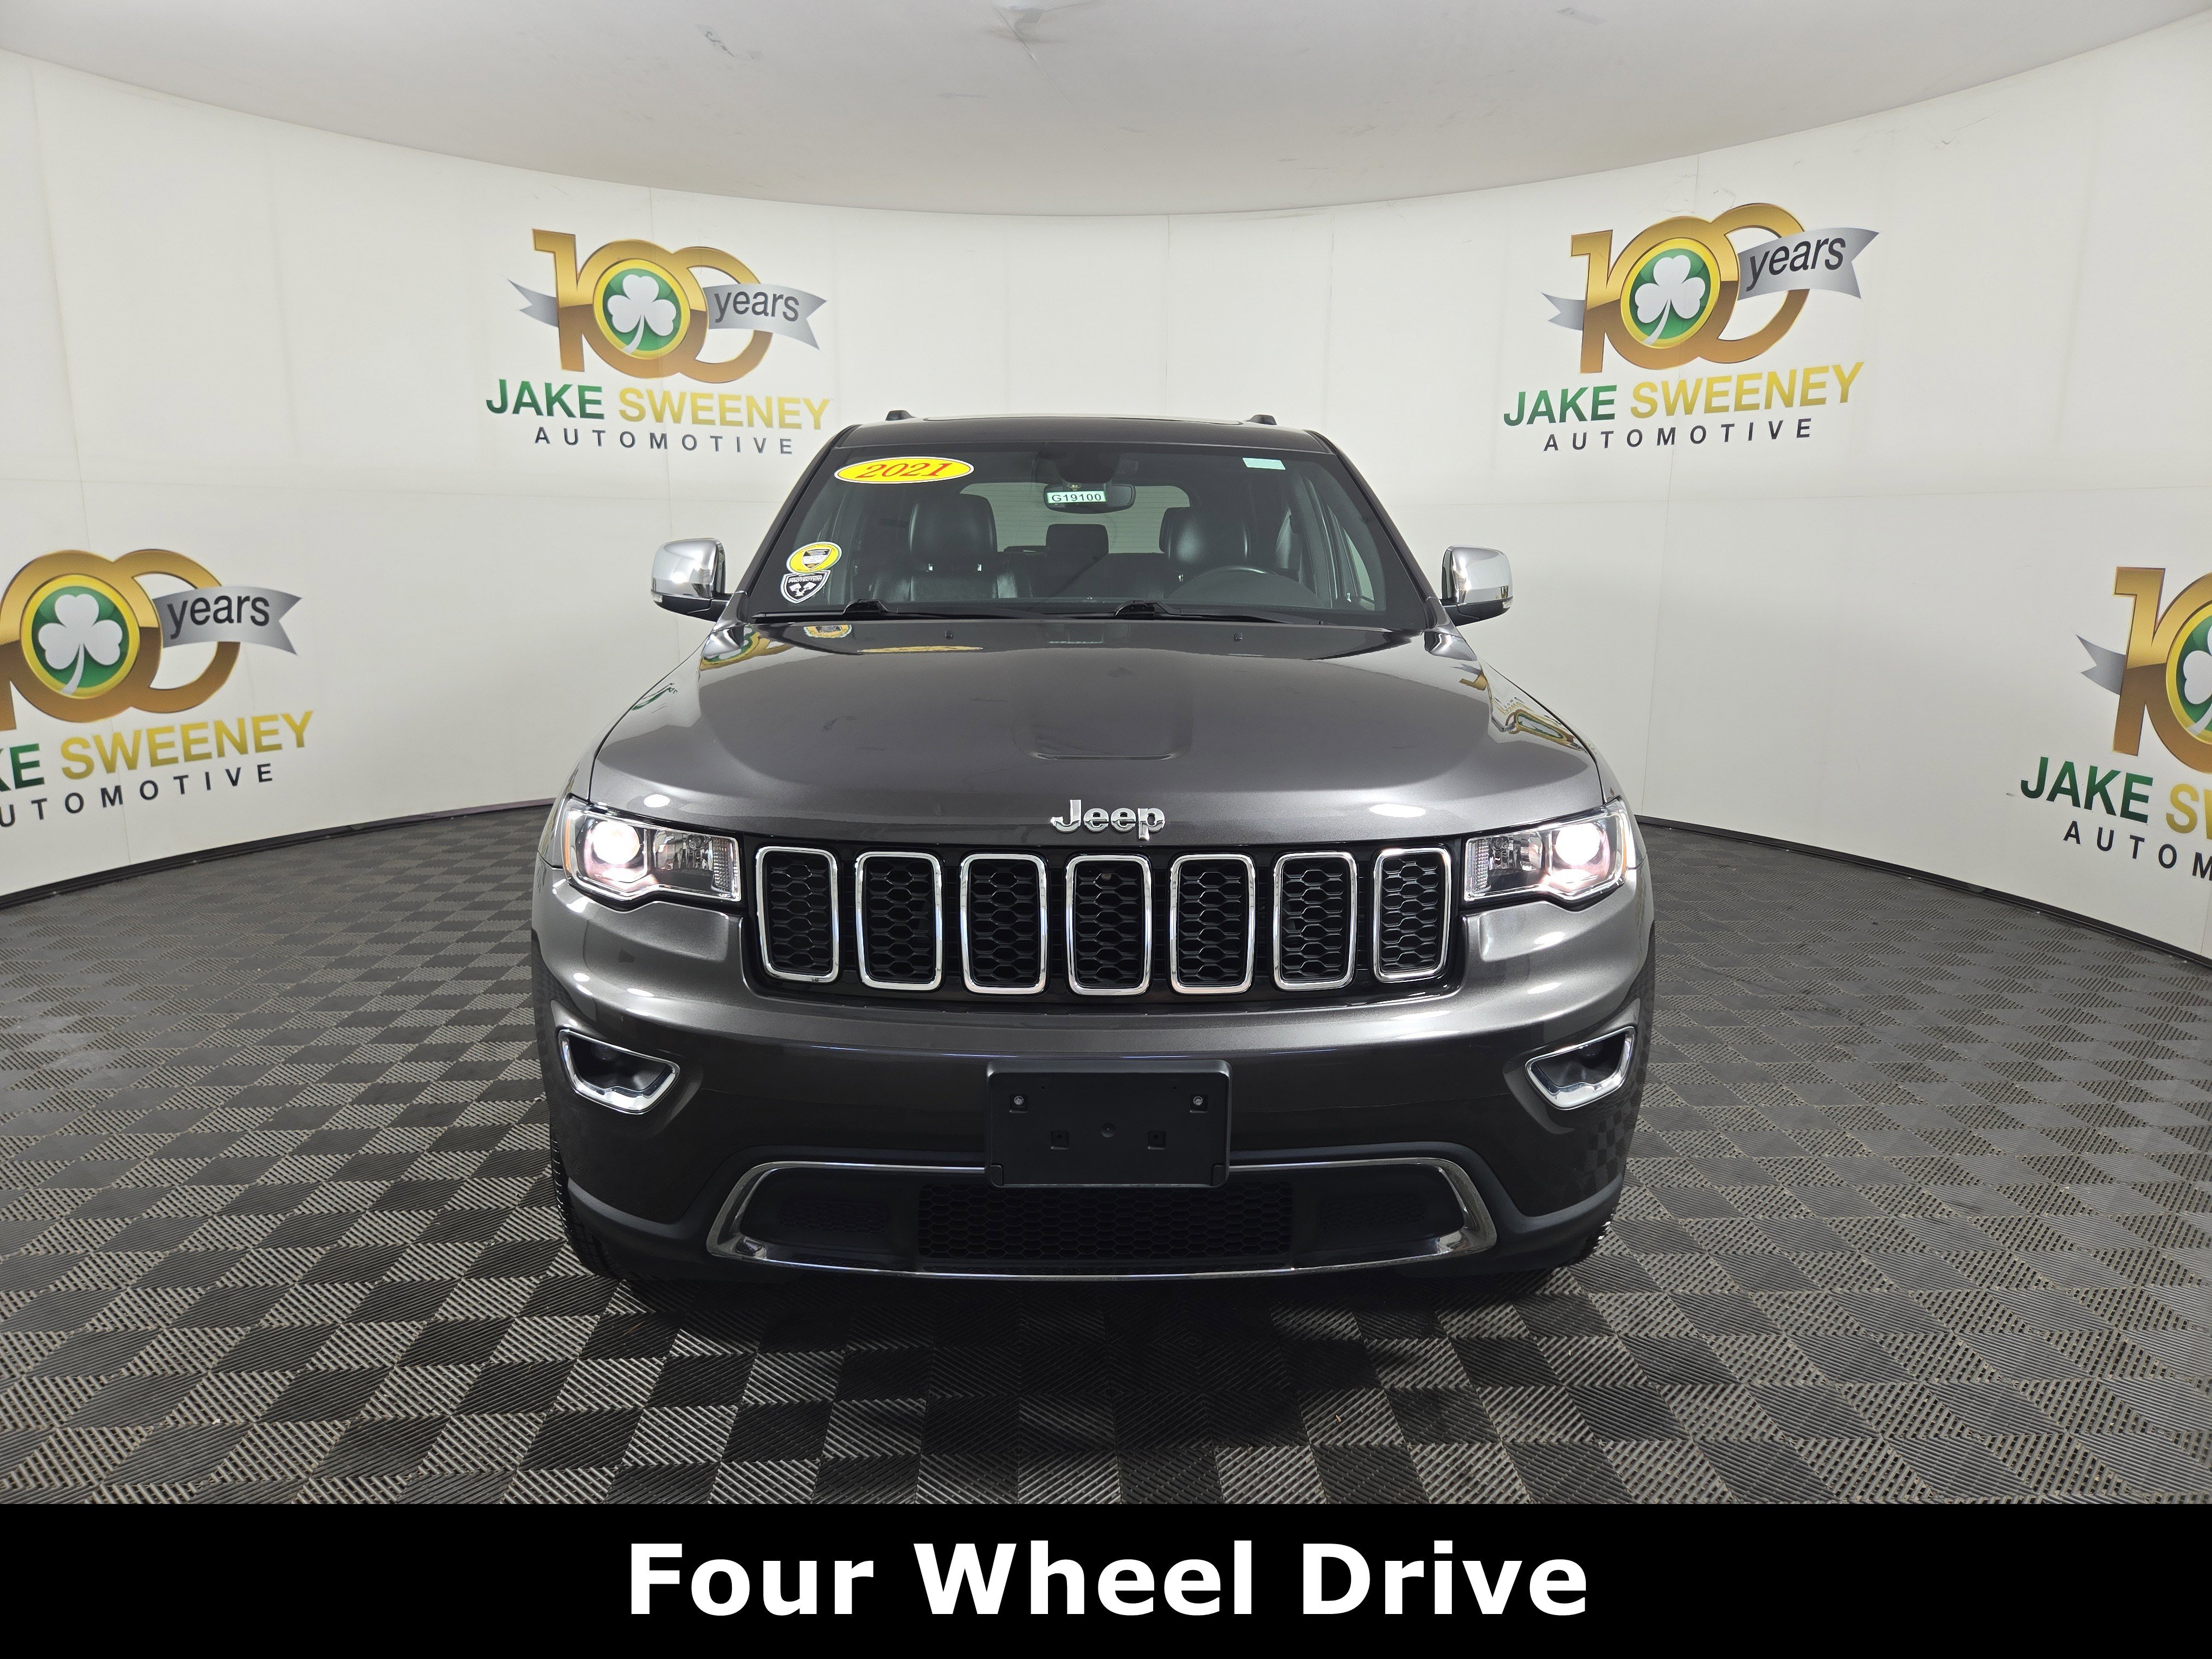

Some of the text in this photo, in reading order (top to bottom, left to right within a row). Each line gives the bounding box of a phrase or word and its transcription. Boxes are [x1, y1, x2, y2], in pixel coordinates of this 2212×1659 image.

[532, 228, 799, 384] 100 years
[1571, 203, 1846, 374] 100 years
[486, 378, 830, 430] JAKE SWEENEY
[1504, 362, 1864, 426] JAKE SWEENEY
[535, 427, 793, 454] AUTOMOTIVE
[1544, 418, 1812, 451] AUTOMOTIVE
[855, 463, 953, 478] 2021
[1052, 494, 1102, 502] G19100
[0, 549, 270, 730] 00 years
[61, 711, 313, 780] SWEENEY
[0, 763, 273, 827] UTOMOTIVE
[1050, 800, 1165, 841] Jeep
[2021, 756, 2153, 824] JAKE
[2063, 820, 2212, 881] AUTOM
